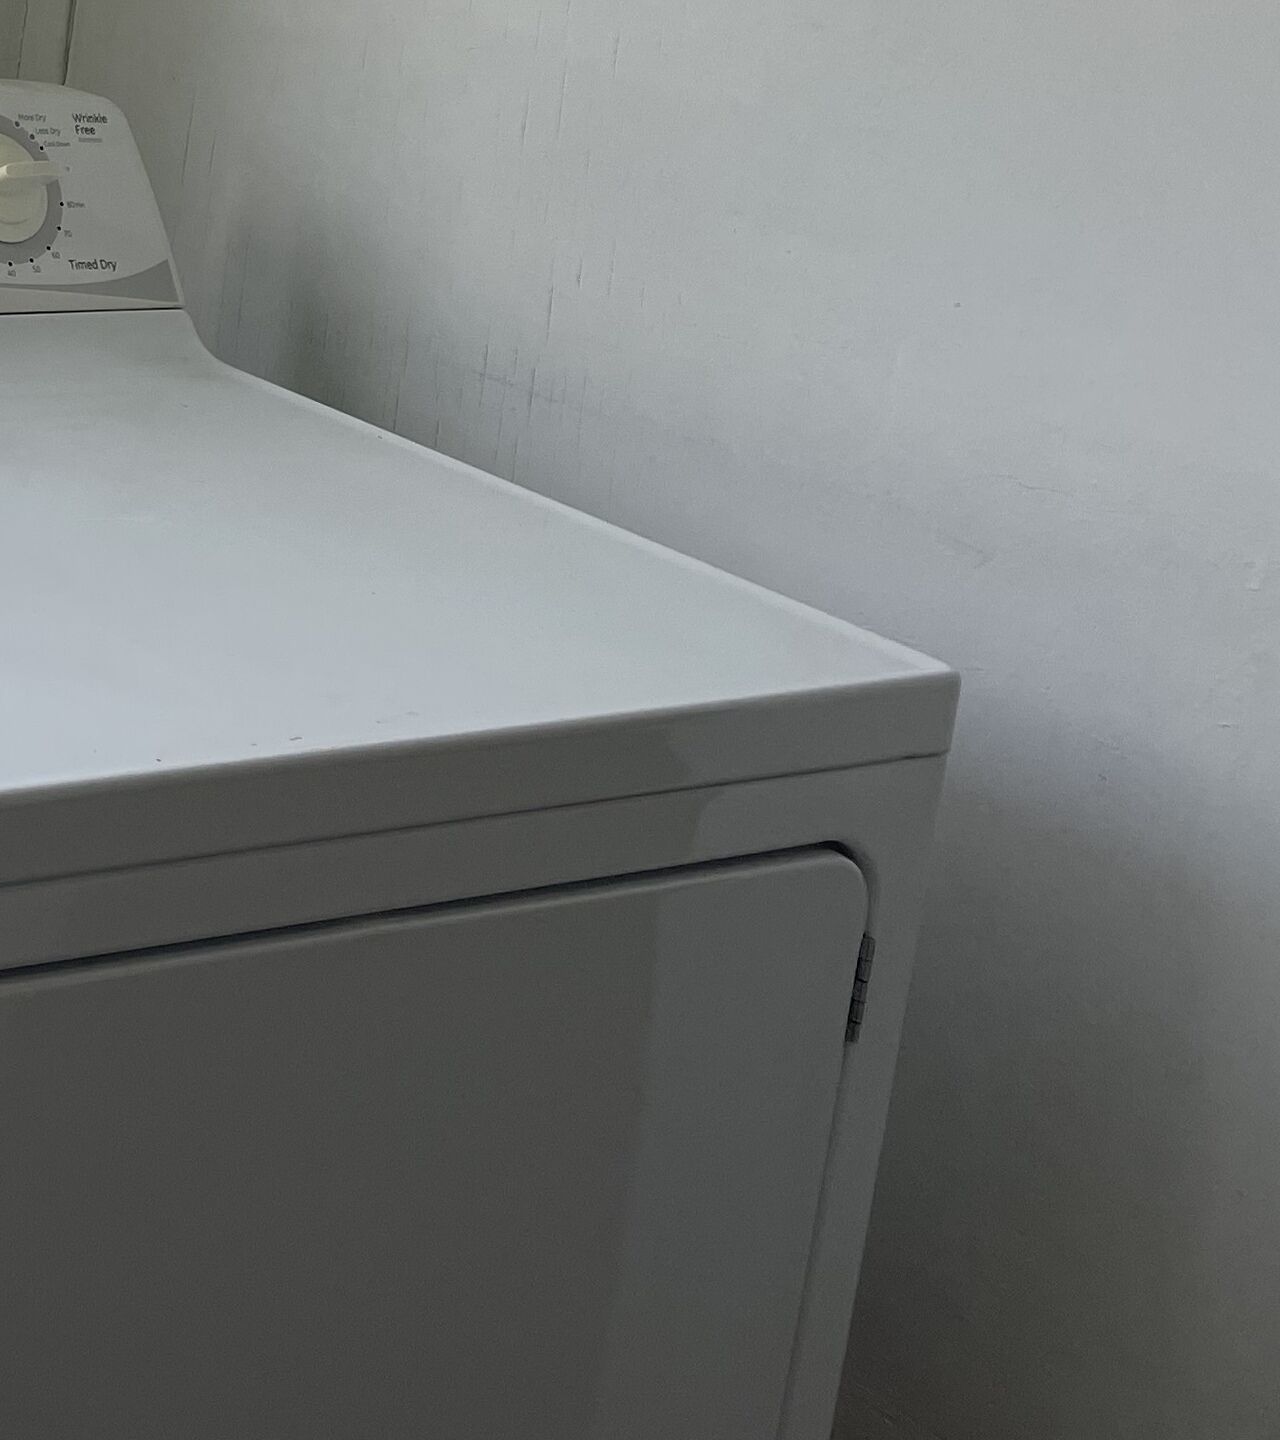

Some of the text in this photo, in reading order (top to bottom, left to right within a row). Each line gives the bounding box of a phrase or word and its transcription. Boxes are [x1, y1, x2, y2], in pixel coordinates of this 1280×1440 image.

[72, 113, 108, 123] Wrinkle
[75, 124, 96, 135] Free
[69, 259, 117, 271] Timed Dry
